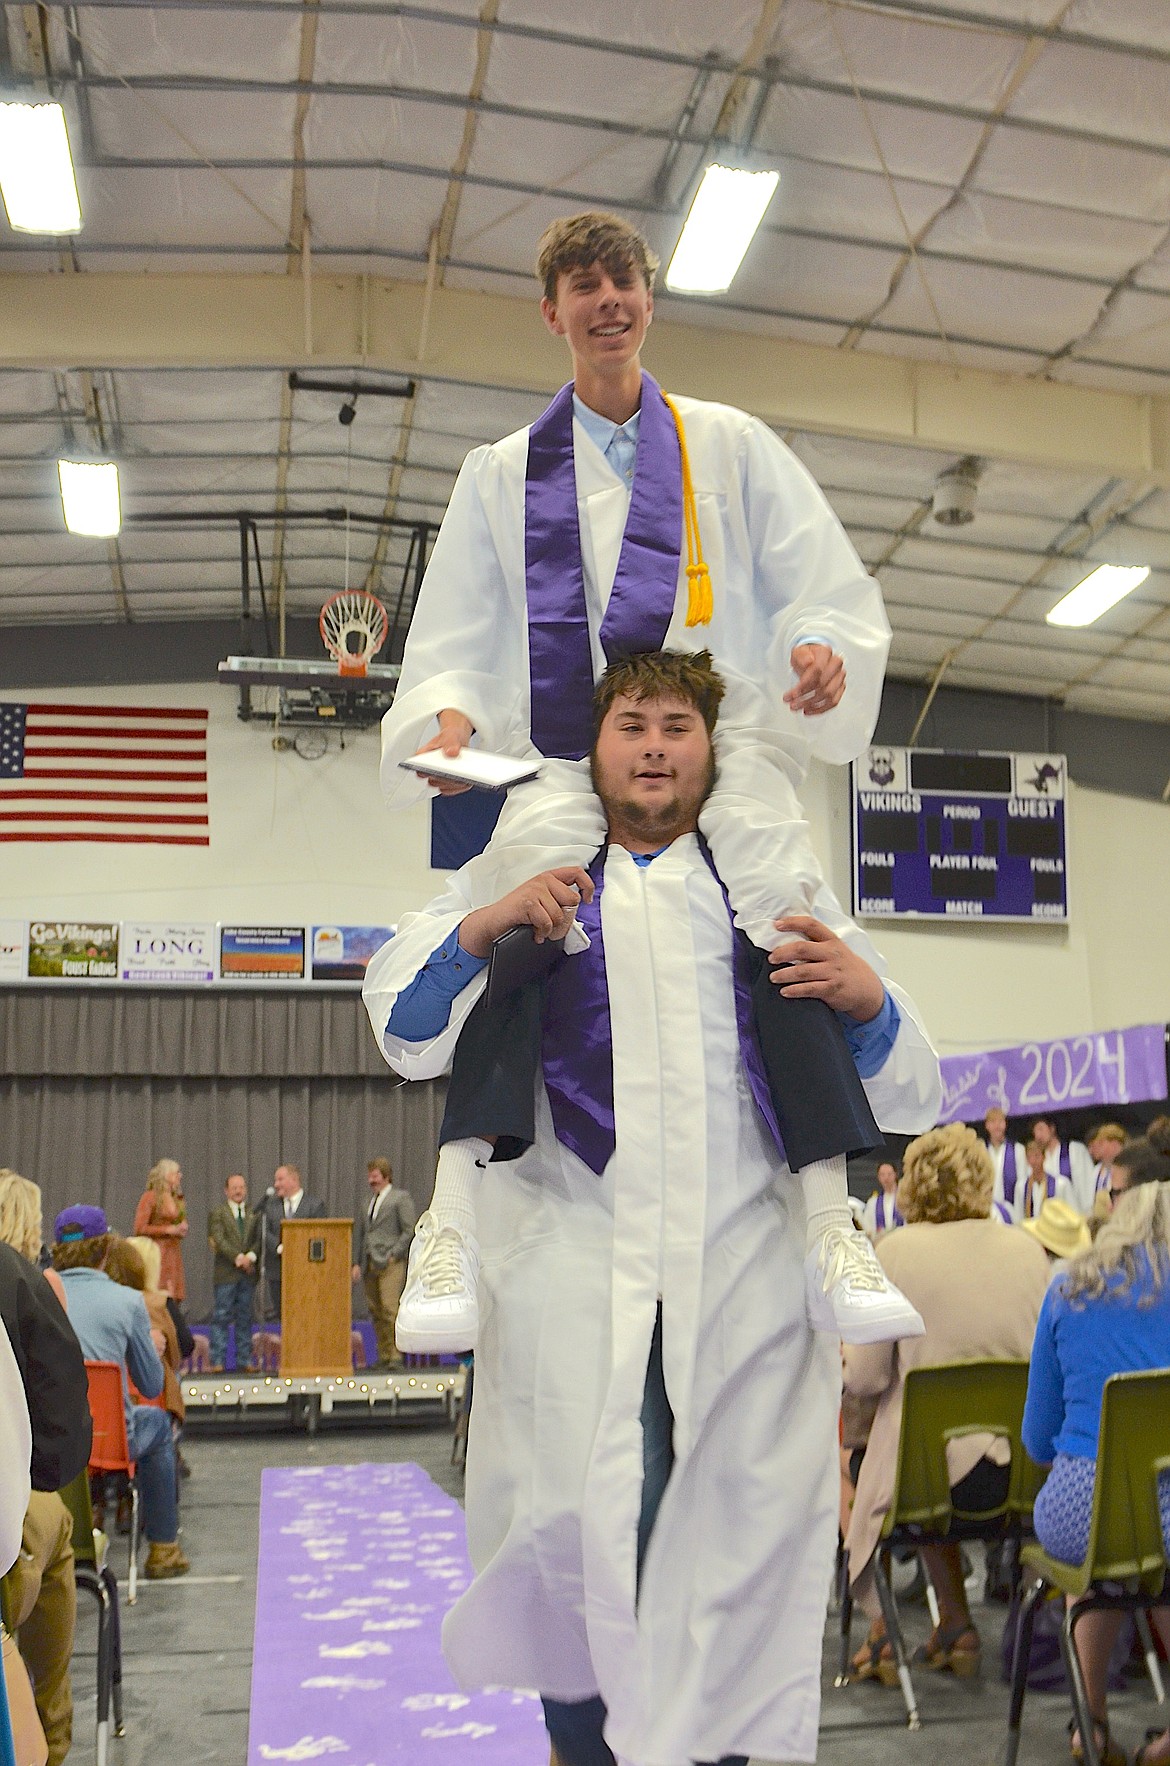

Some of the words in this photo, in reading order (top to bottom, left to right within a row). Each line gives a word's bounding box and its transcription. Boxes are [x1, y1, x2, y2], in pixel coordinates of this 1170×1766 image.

[860, 792, 922, 813] VIKINGS
[1008, 798, 1056, 818] GUEST
[943, 804, 981, 819] PERIOD
[860, 851, 895, 867] FOULS
[929, 854, 970, 870] PLAYER
[1030, 857, 1063, 873] FOULS
[945, 900, 983, 914] MATCH
[31, 922, 55, 945] Go
[55, 923, 118, 946] Vikings!
[135, 939, 203, 955] LONG
[1019, 1032, 1128, 1106] 2024
